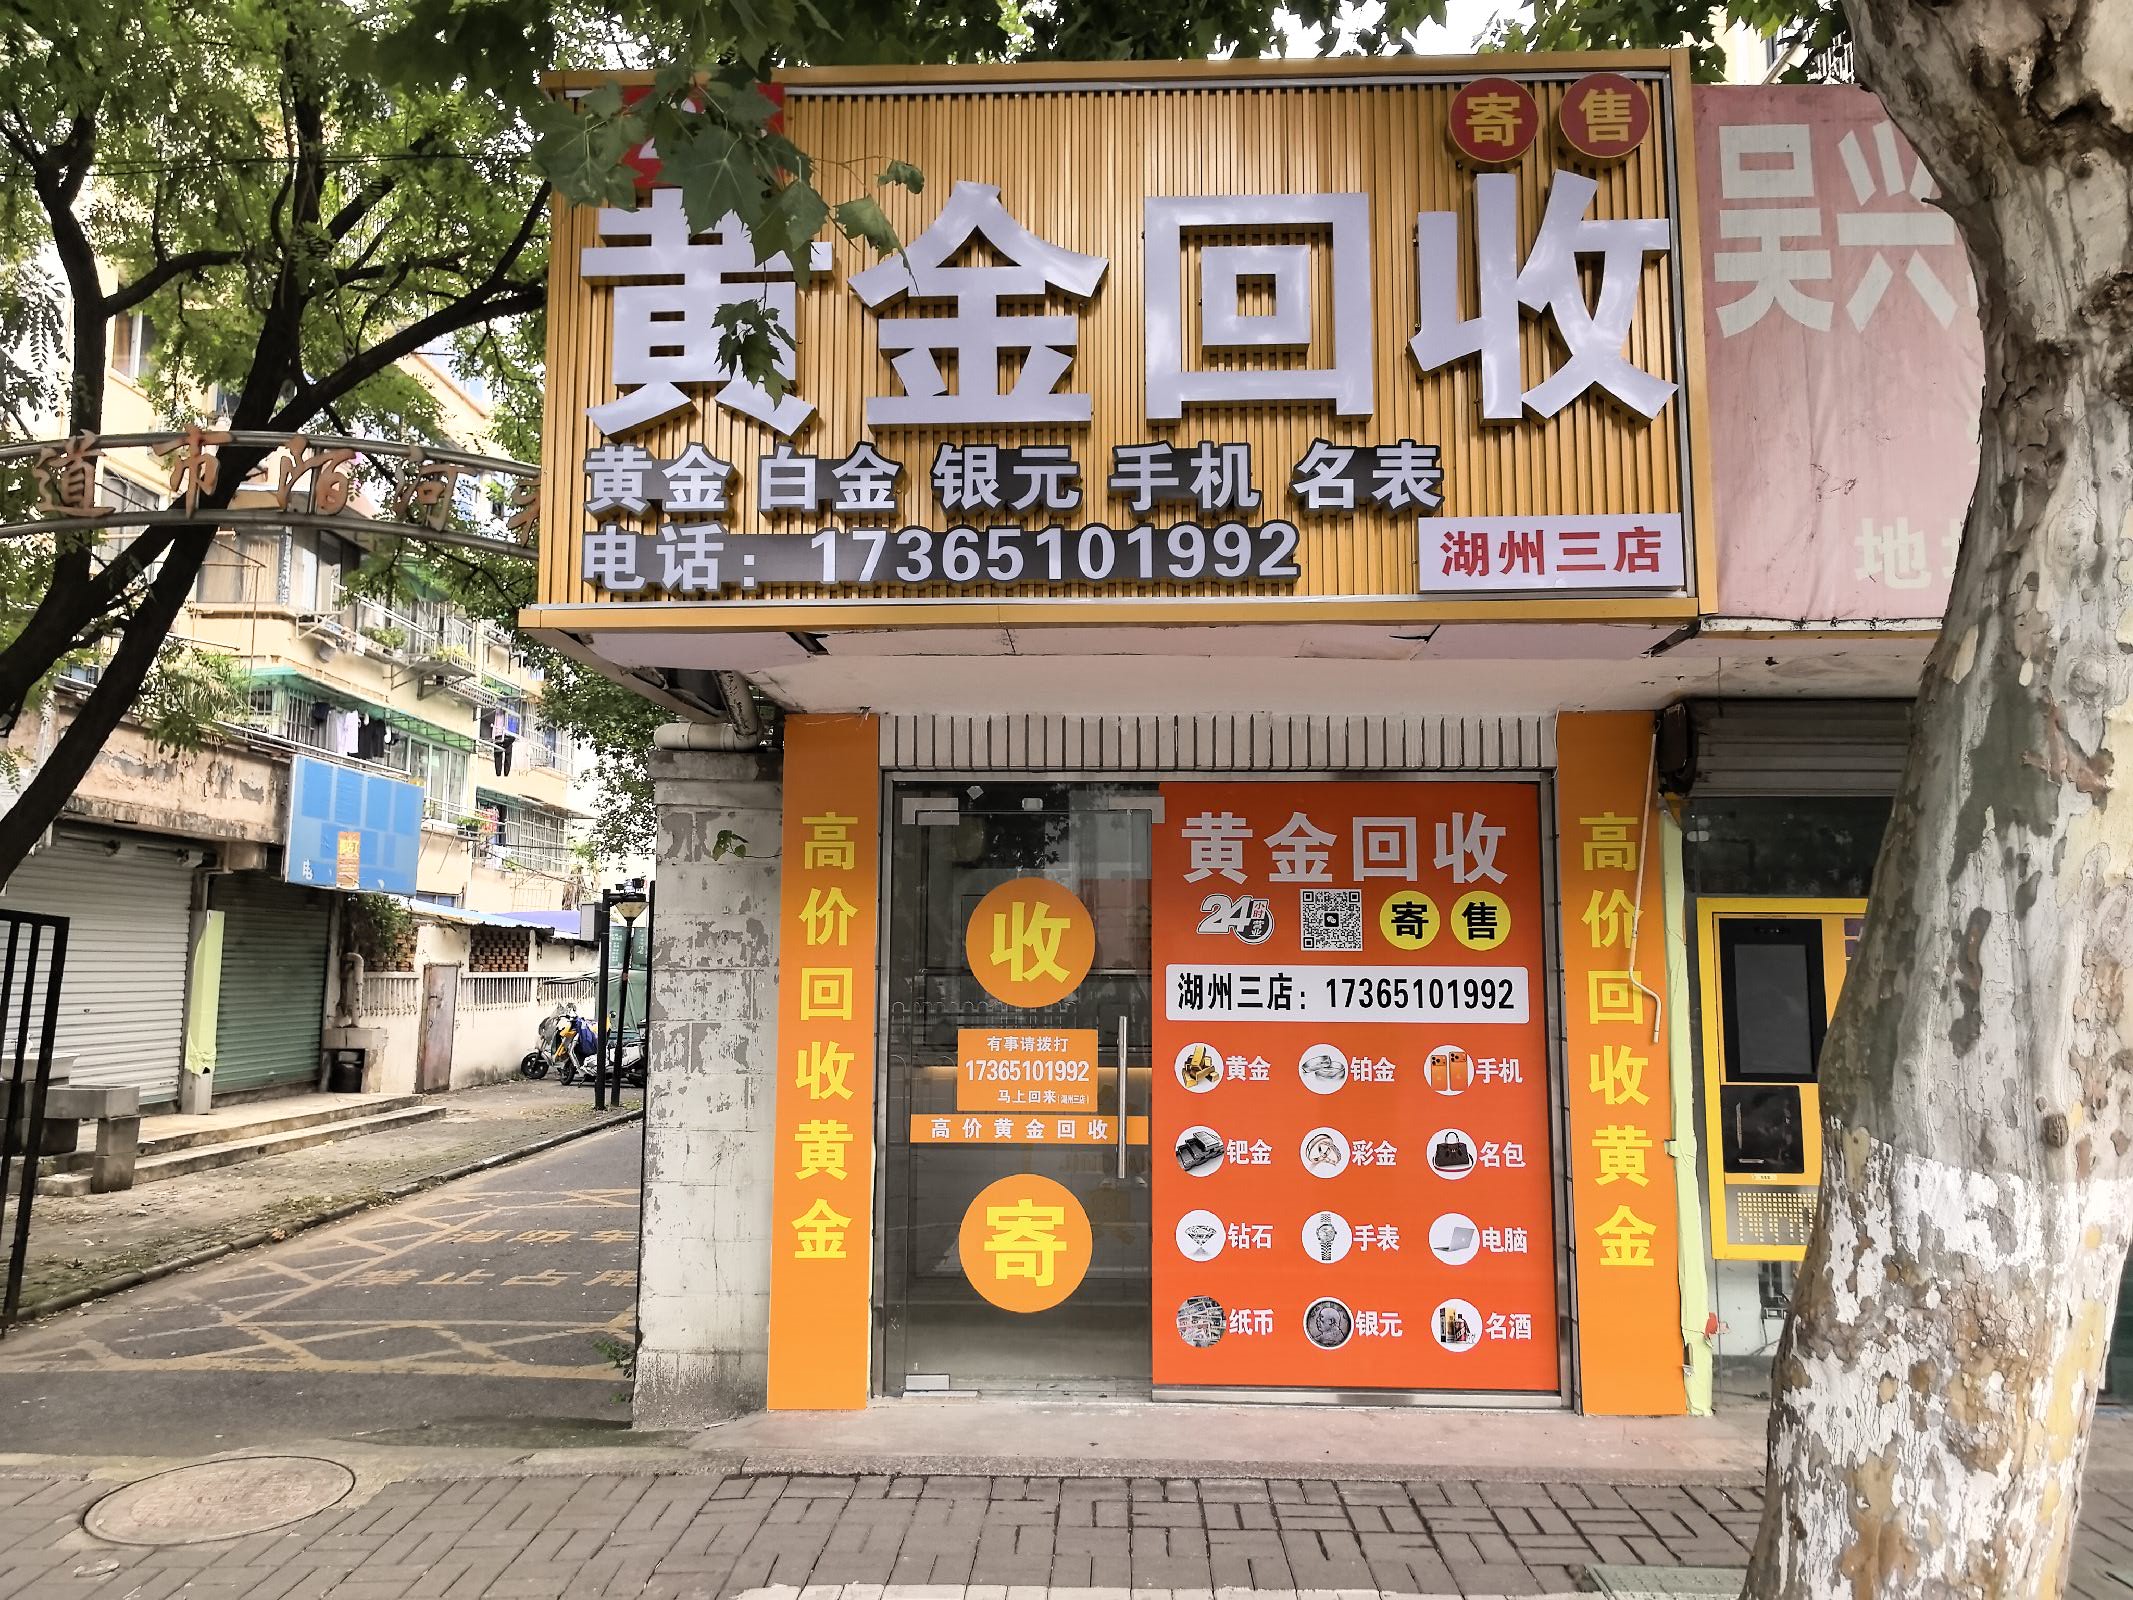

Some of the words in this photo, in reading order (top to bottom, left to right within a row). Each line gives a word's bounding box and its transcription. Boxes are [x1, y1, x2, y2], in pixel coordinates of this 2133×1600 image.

[1465, 88, 1634, 148] 寄售
[1714, 119, 1977, 338] 吴兴
[580, 169, 1680, 437] 黄金回收
[584, 443, 730, 513] 黄金
[760, 445, 900, 512] 白金
[933, 444, 1081, 512] 银元
[1110, 442, 1259, 511] 手机
[1293, 442, 1443, 511] 名表
[583, 525, 757, 590] 电话：
[810, 523, 1300, 582] 17365101992
[1441, 526, 1662, 577] 湖州三店
[1181, 811, 1507, 885] 黄金回收
[1199, 895, 1252, 933] 24
[1390, 901, 1498, 940] 寄售
[989, 900, 1071, 983] 收
[1177, 972, 1306, 1011] 湖州三店：
[1326, 977, 1515, 1010] 17365101992
[791, 811, 858, 1260] 高价回收黄金
[986, 1035, 1069, 1053] 有事请拨打
[1578, 811, 1658, 1268] 高价回收黄金
[965, 1059, 1090, 1082] 17365101992
[1225, 1055, 1271, 1081] 黄金
[1350, 1056, 1396, 1082] 铂金
[1475, 1057, 1523, 1084] 手机
[997, 1089, 1057, 1104] 马上回来
[931, 1117, 1108, 1140] 高价黄金回收
[1226, 1138, 1273, 1165] 钯金
[1351, 1139, 1398, 1166] 彩金
[1478, 1140, 1527, 1168] 名包
[983, 1198, 1068, 1287] 寄
[1227, 1222, 1274, 1249] 钻石
[1352, 1224, 1400, 1252] 手表
[1481, 1226, 1528, 1254] 电脑
[1228, 1308, 1274, 1336] 纸币
[1354, 1310, 1403, 1338] 银元
[1484, 1312, 1532, 1340] 名酒
